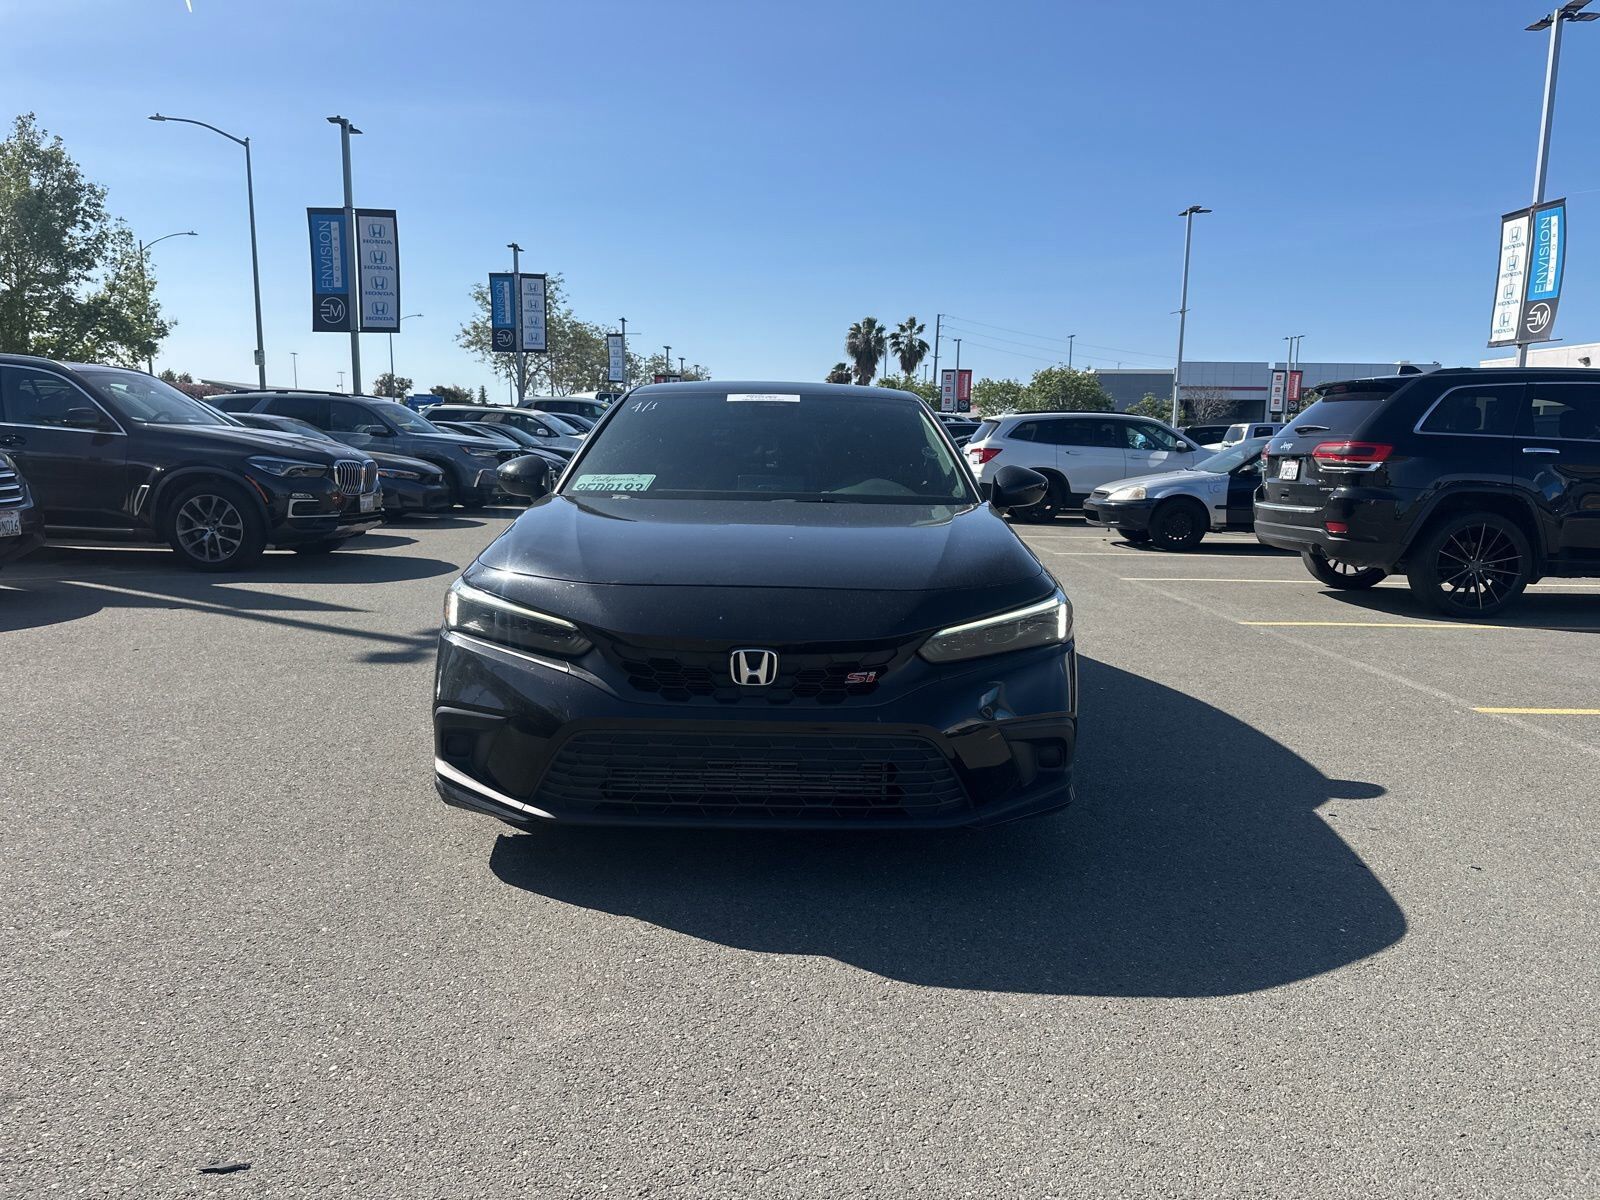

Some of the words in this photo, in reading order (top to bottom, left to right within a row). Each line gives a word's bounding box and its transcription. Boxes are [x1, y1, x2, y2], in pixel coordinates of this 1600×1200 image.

[319, 221, 333, 288] ENVISION
[1504, 242, 1525, 250] HONDA
[1535, 217, 1551, 293] ENVISION
[1502, 271, 1522, 279] HONDA
[496, 281, 505, 324] ENVISION
[845, 671, 876, 684] Si
